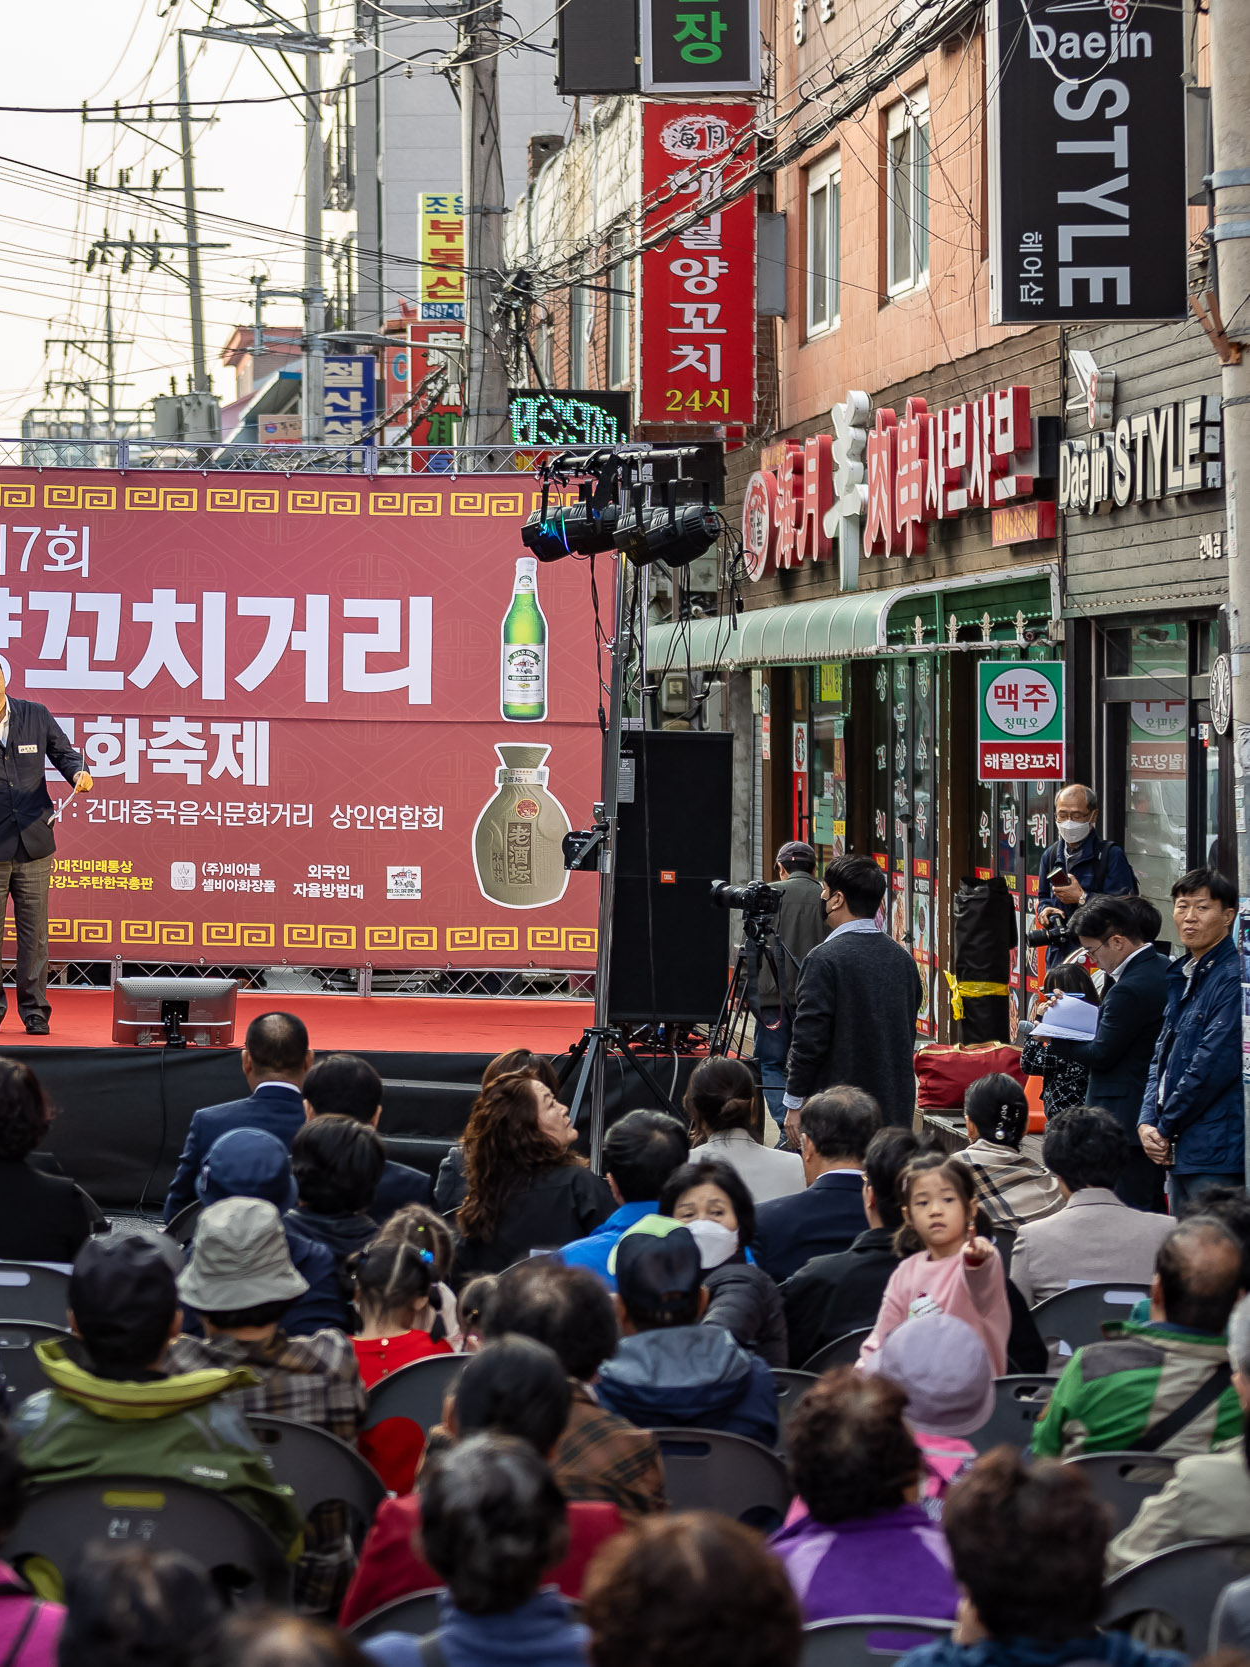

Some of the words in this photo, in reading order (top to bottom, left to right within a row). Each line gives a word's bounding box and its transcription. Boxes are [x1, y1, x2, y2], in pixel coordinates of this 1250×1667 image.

[672, 0, 728, 64] 장
[1029, 24, 1152, 63] Daejin
[1053, 79, 1130, 308] STYLE
[1019, 231, 1044, 306] 헤어샵
[666, 388, 730, 415] 24시
[1057, 438, 1115, 516] Daejin
[1114, 402, 1203, 508] STYLE
[993, 683, 1050, 713] 맥주
[1003, 716, 1040, 730] 칭따오
[983, 751, 1061, 771] 해월양꼬치
[84, 798, 315, 829] 건대중국음식문화거리
[329, 803, 444, 831] 상인연합회
[50, 858, 134, 873] )대진미래통상
[201, 861, 262, 877] (주)비아블
[306, 863, 351, 880] 외국인
[201, 877, 277, 893] 셀비아화장품
[292, 882, 365, 900] 자율방범대
